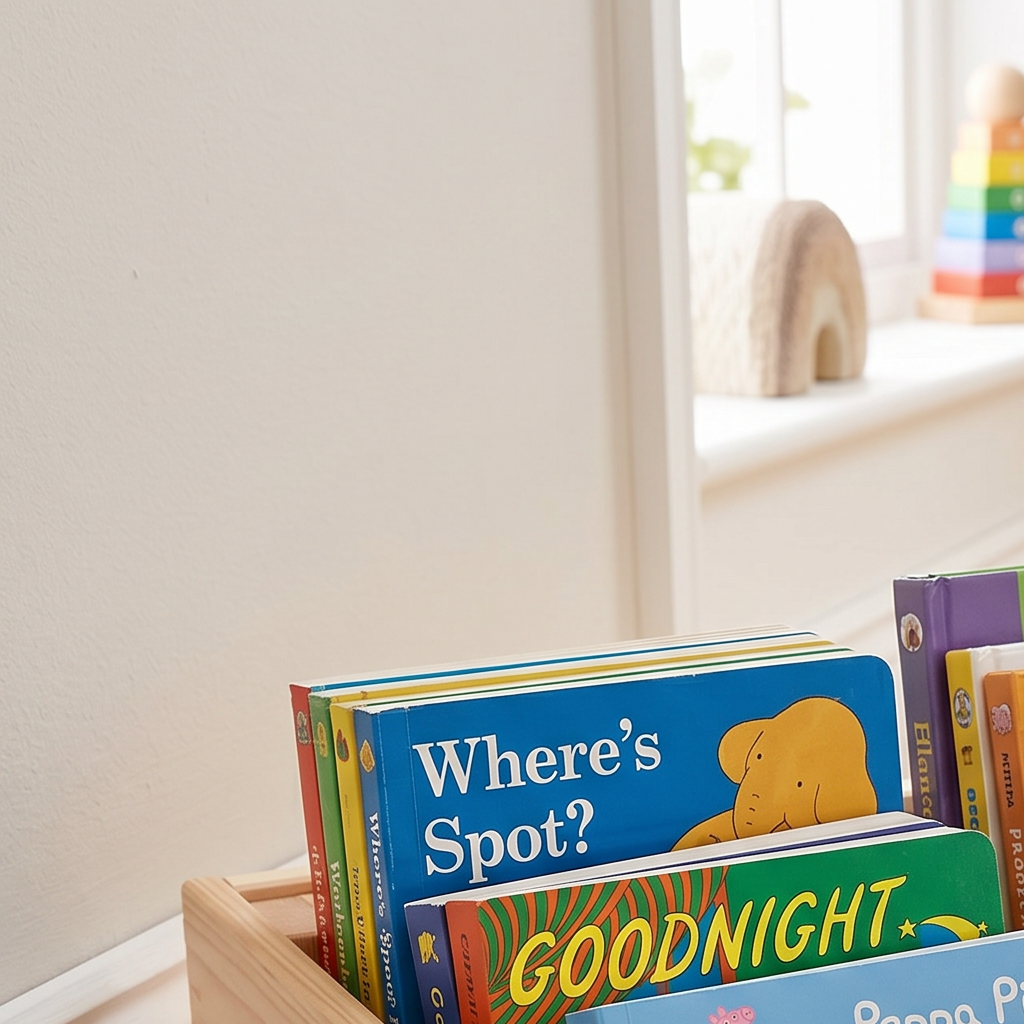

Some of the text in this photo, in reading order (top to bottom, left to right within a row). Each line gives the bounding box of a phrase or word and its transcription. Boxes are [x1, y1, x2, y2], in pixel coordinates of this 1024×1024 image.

[412, 718, 661, 798] Where's
[425, 798, 594, 885] Spot?
[509, 875, 907, 1006] GOODNIGHT
